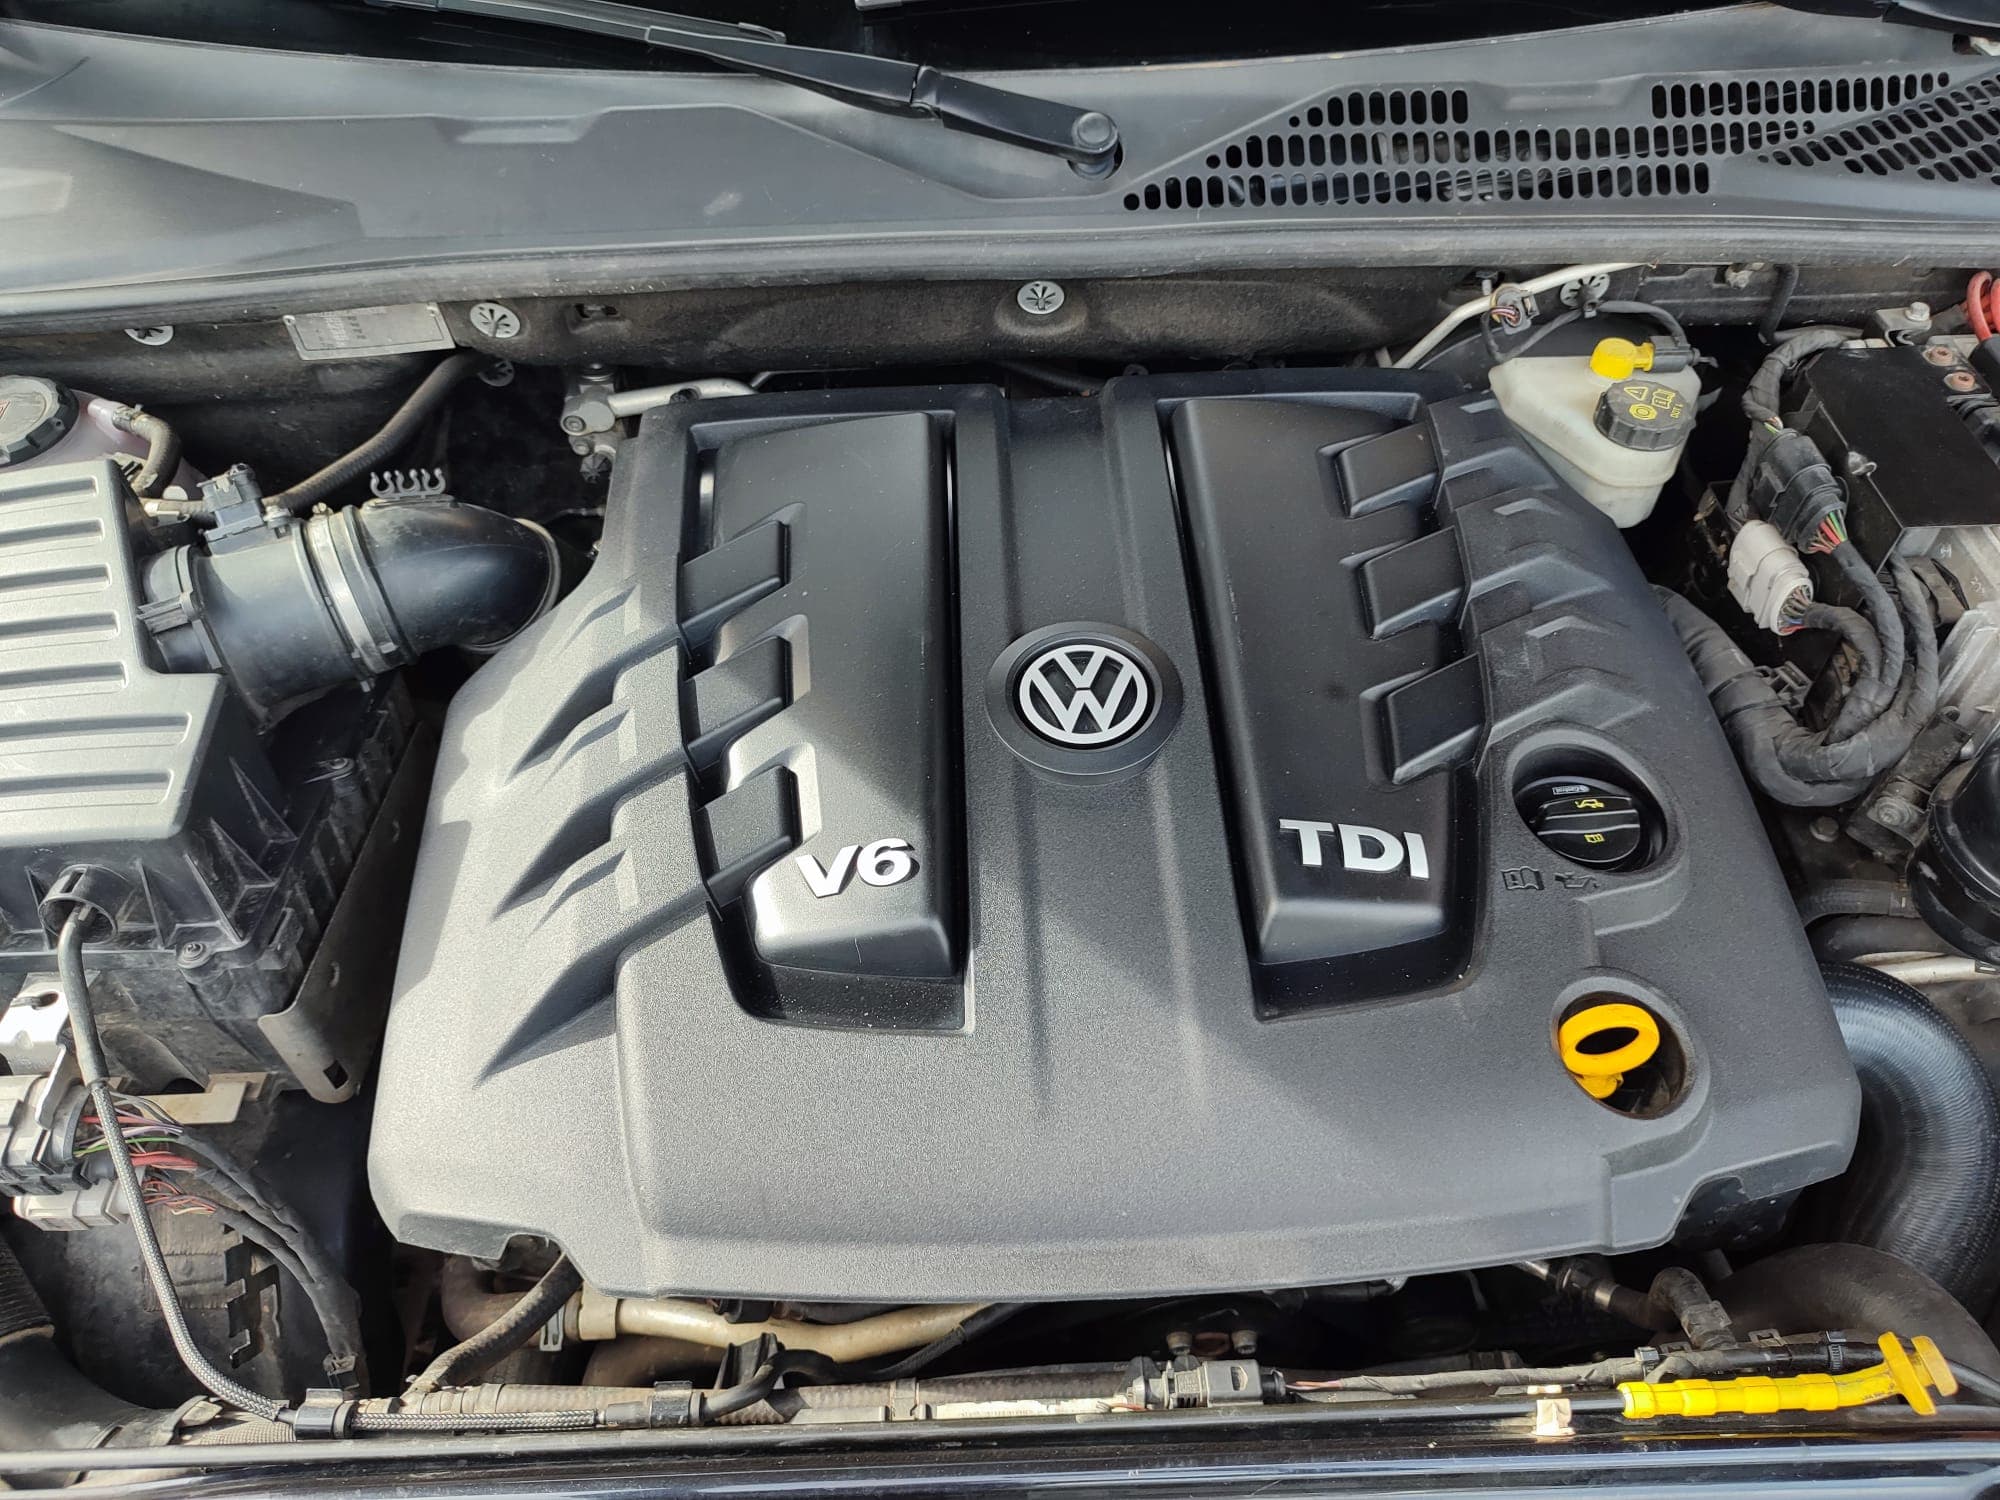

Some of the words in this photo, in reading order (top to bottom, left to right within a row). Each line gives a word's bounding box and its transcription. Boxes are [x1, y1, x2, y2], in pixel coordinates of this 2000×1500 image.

[1020, 645, 1148, 744] VW
[795, 838, 918, 898] V6
[1279, 818, 1430, 880] TDI
